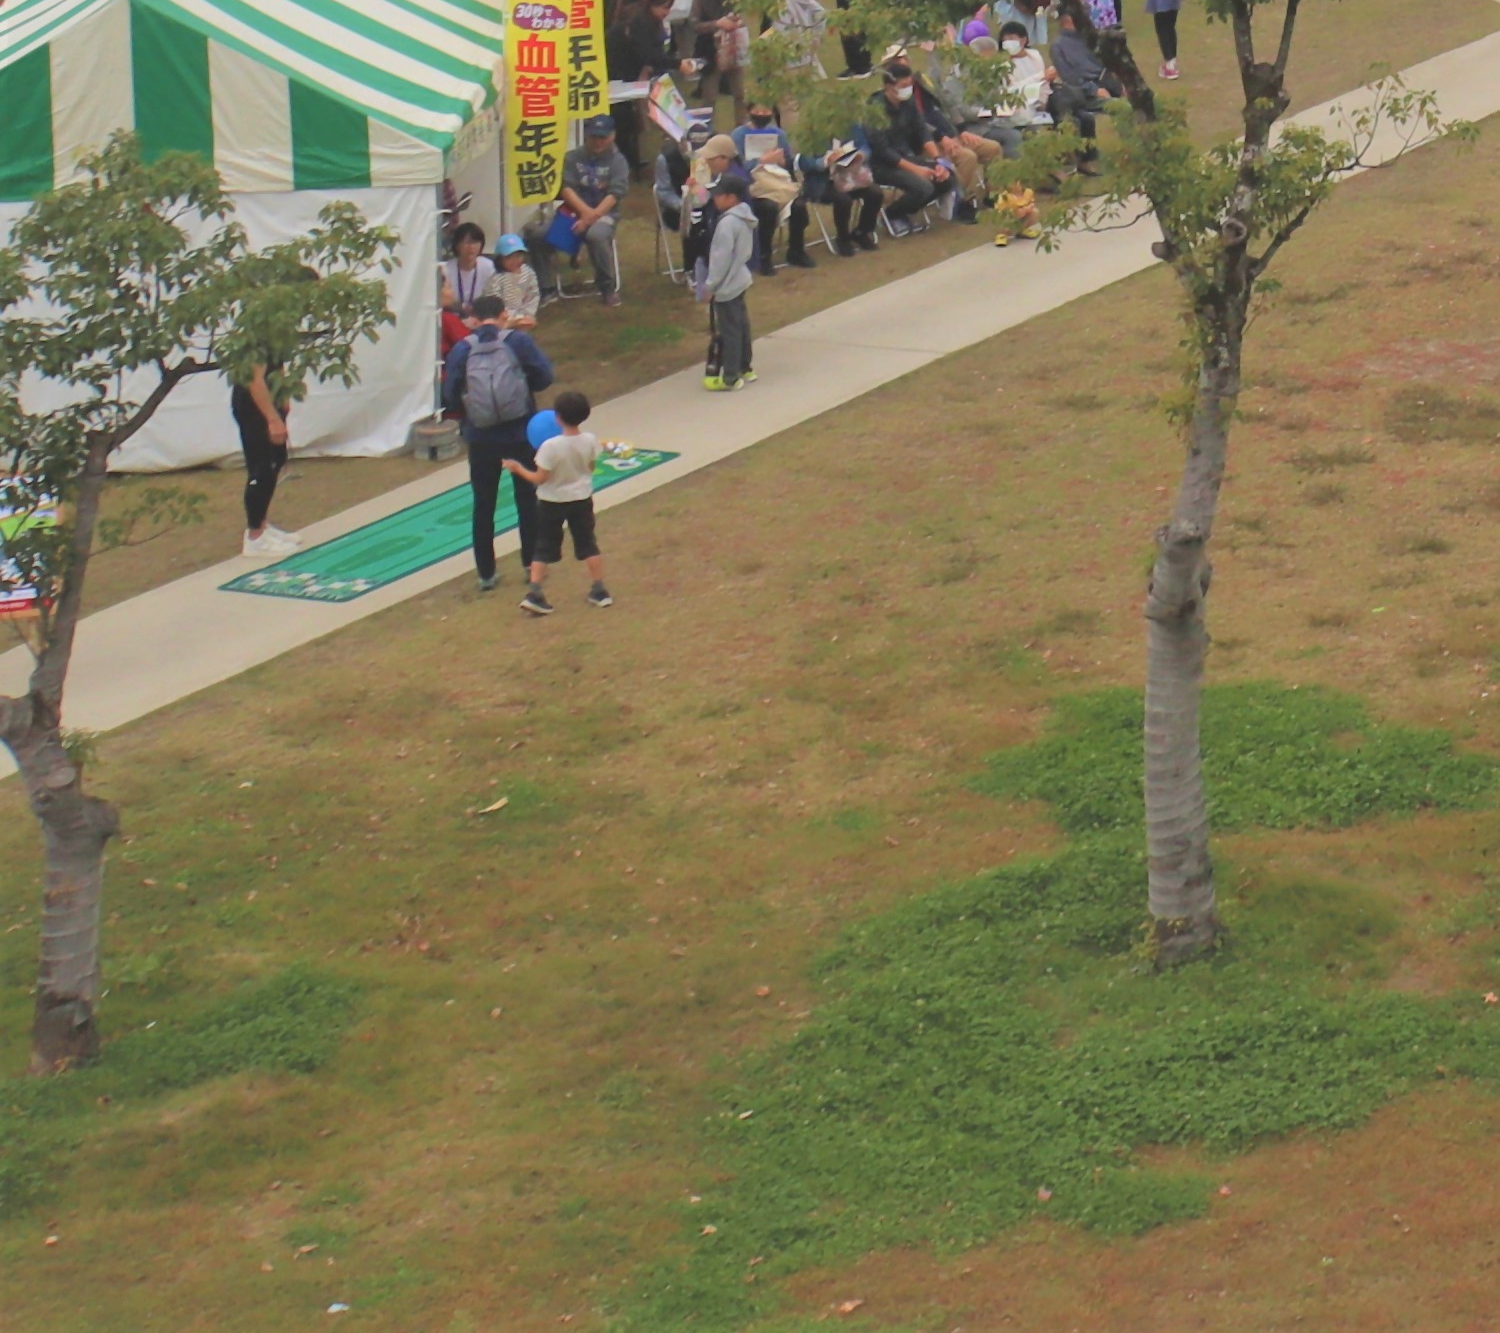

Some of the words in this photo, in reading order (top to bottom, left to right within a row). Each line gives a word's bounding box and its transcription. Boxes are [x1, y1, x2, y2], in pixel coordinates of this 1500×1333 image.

[531, 17, 567, 30] わかる
[514, 33, 562, 199] 血管年齢
